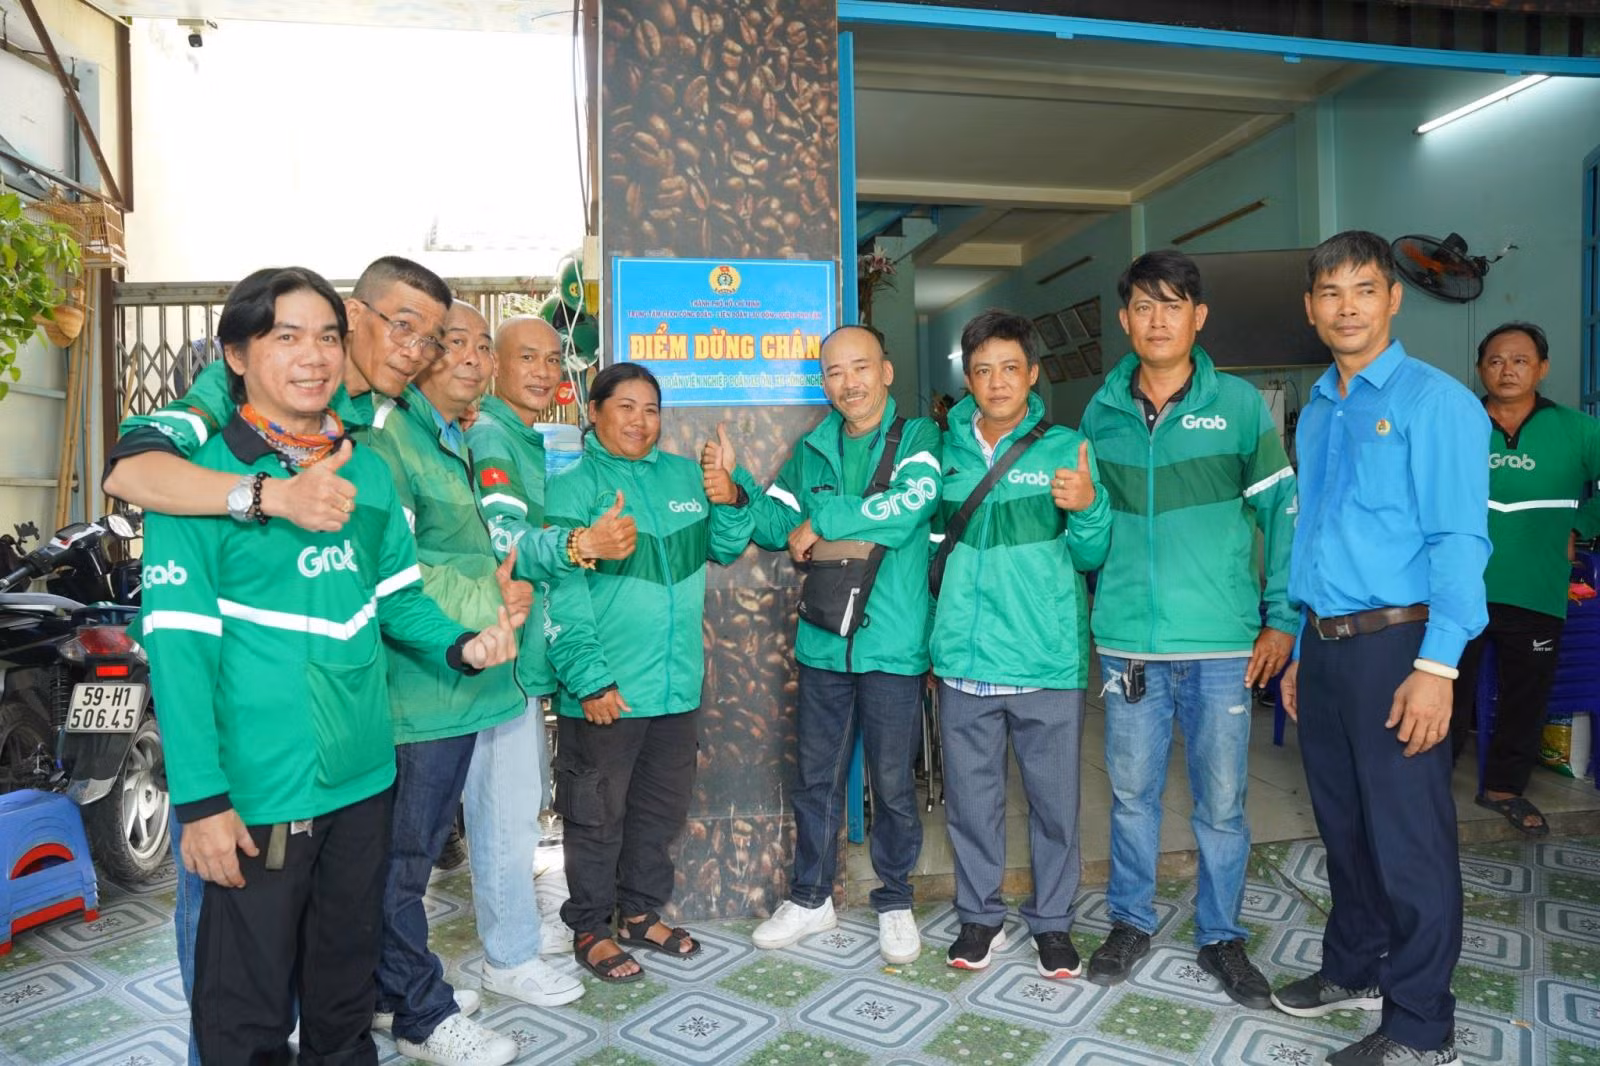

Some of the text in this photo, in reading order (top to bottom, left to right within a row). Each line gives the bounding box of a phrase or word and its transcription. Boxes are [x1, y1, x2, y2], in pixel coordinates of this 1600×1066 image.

[629, 321, 821, 360] ĐIỂM DỪNG CHÂN
[1181, 414, 1227, 430] Grab
[1488, 453, 1536, 471] Grab
[1008, 469, 1050, 486] Grab
[668, 498, 702, 512] Grab
[861, 477, 937, 521] Grab
[82, 687, 131, 706] 59-H1
[70, 709, 135, 729] 506.45
